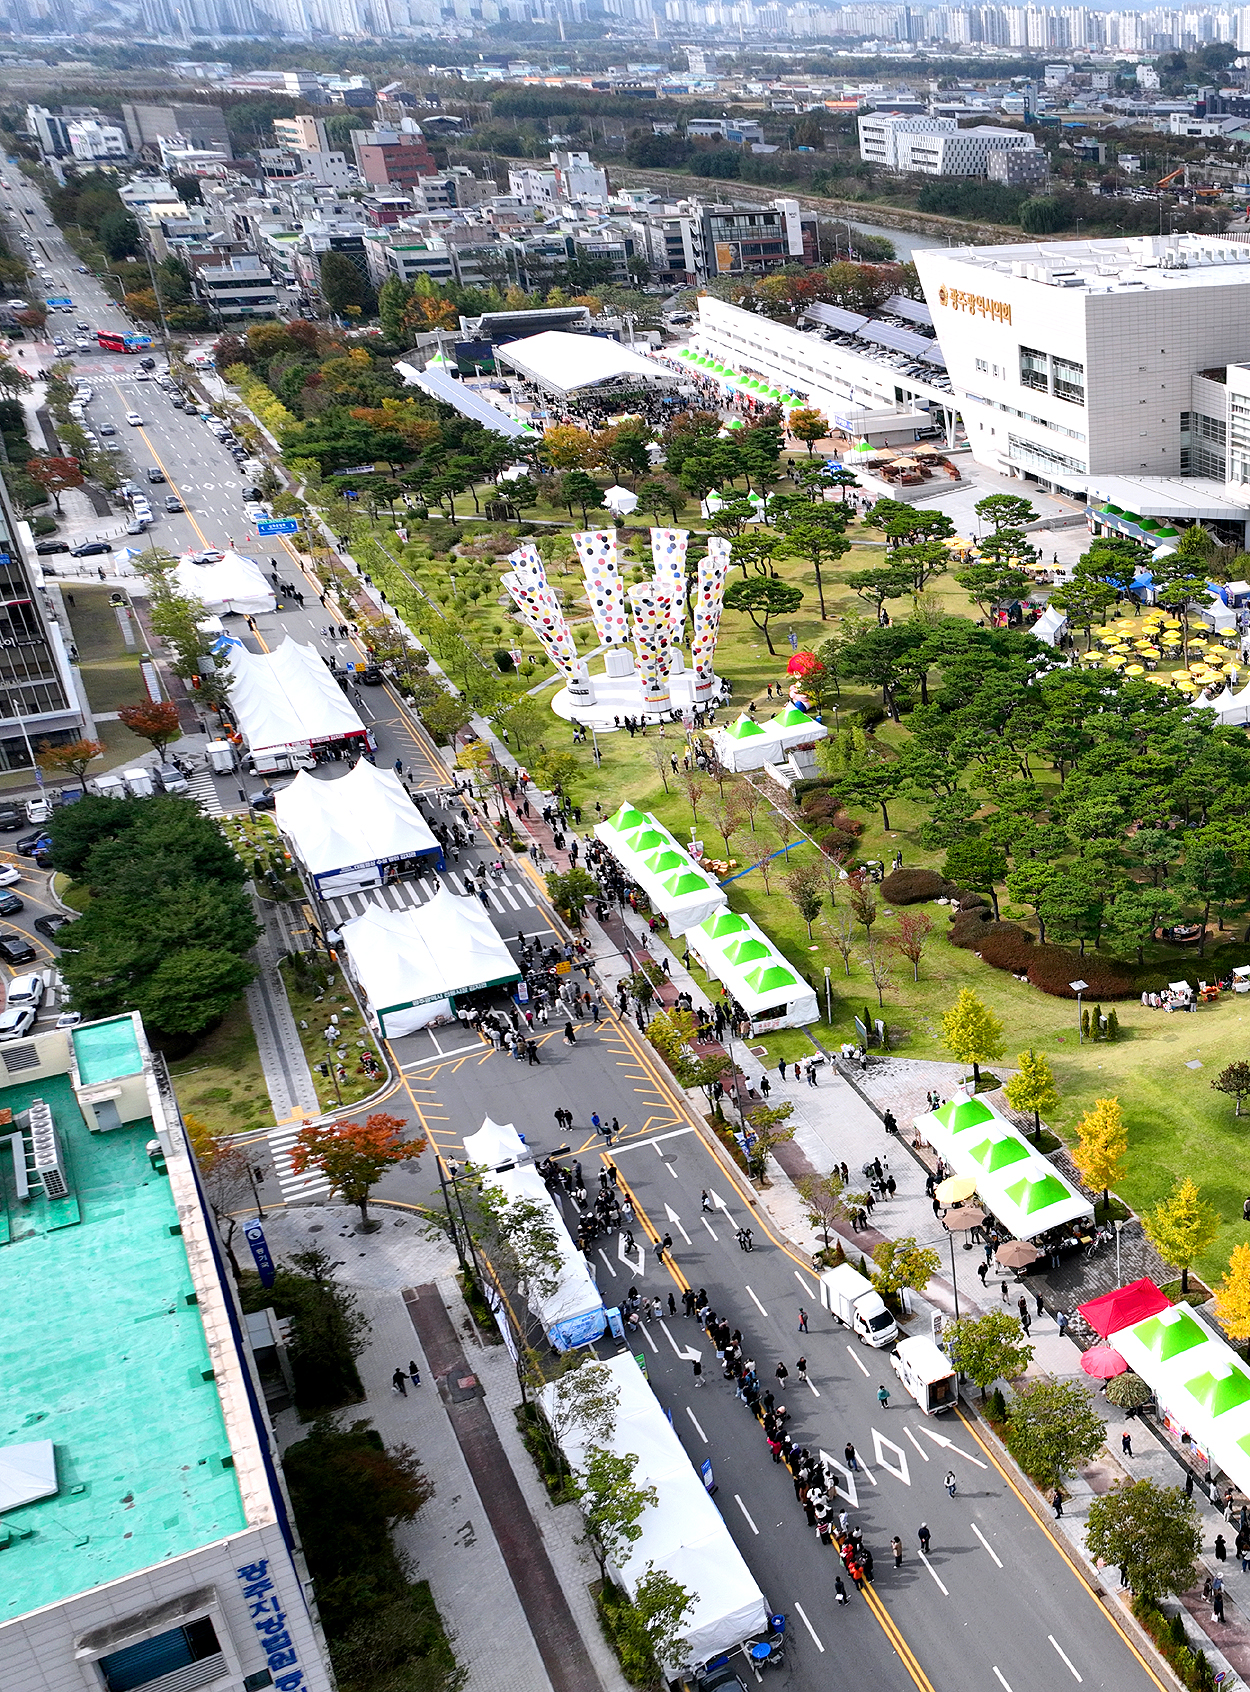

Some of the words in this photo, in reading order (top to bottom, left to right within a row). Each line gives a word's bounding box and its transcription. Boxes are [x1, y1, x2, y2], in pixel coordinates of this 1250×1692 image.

[949, 287, 1012, 325] 광주광역시의회
[237, 1558, 298, 1672] 광주지방법원
[275, 1669, 308, 1692] 등
